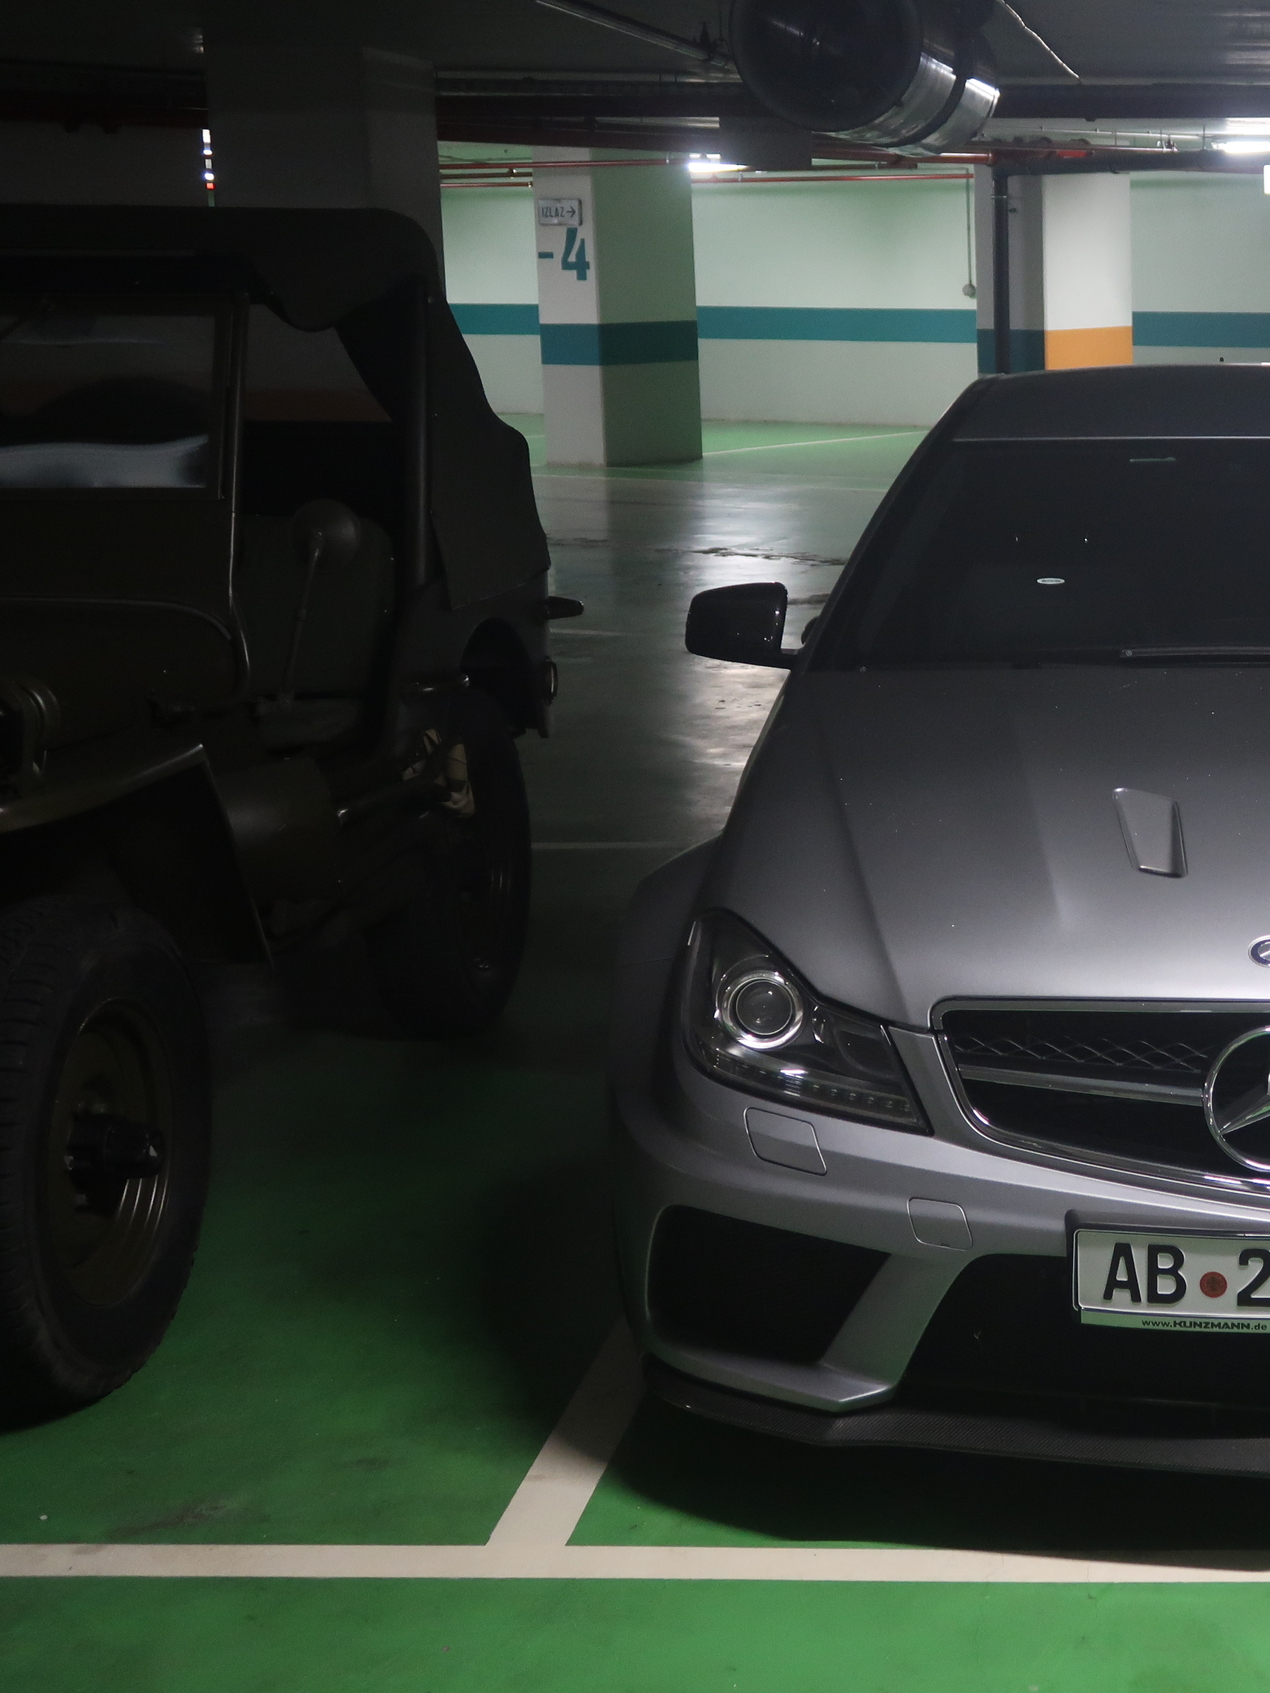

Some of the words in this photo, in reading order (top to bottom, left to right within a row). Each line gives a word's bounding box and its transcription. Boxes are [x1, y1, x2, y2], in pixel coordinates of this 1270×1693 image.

[541, 206, 565, 219] IZLAZ
[1103, 1242, 1188, 1304] AB
[1141, 1319, 1268, 1331] www.KUNZMANN.de
